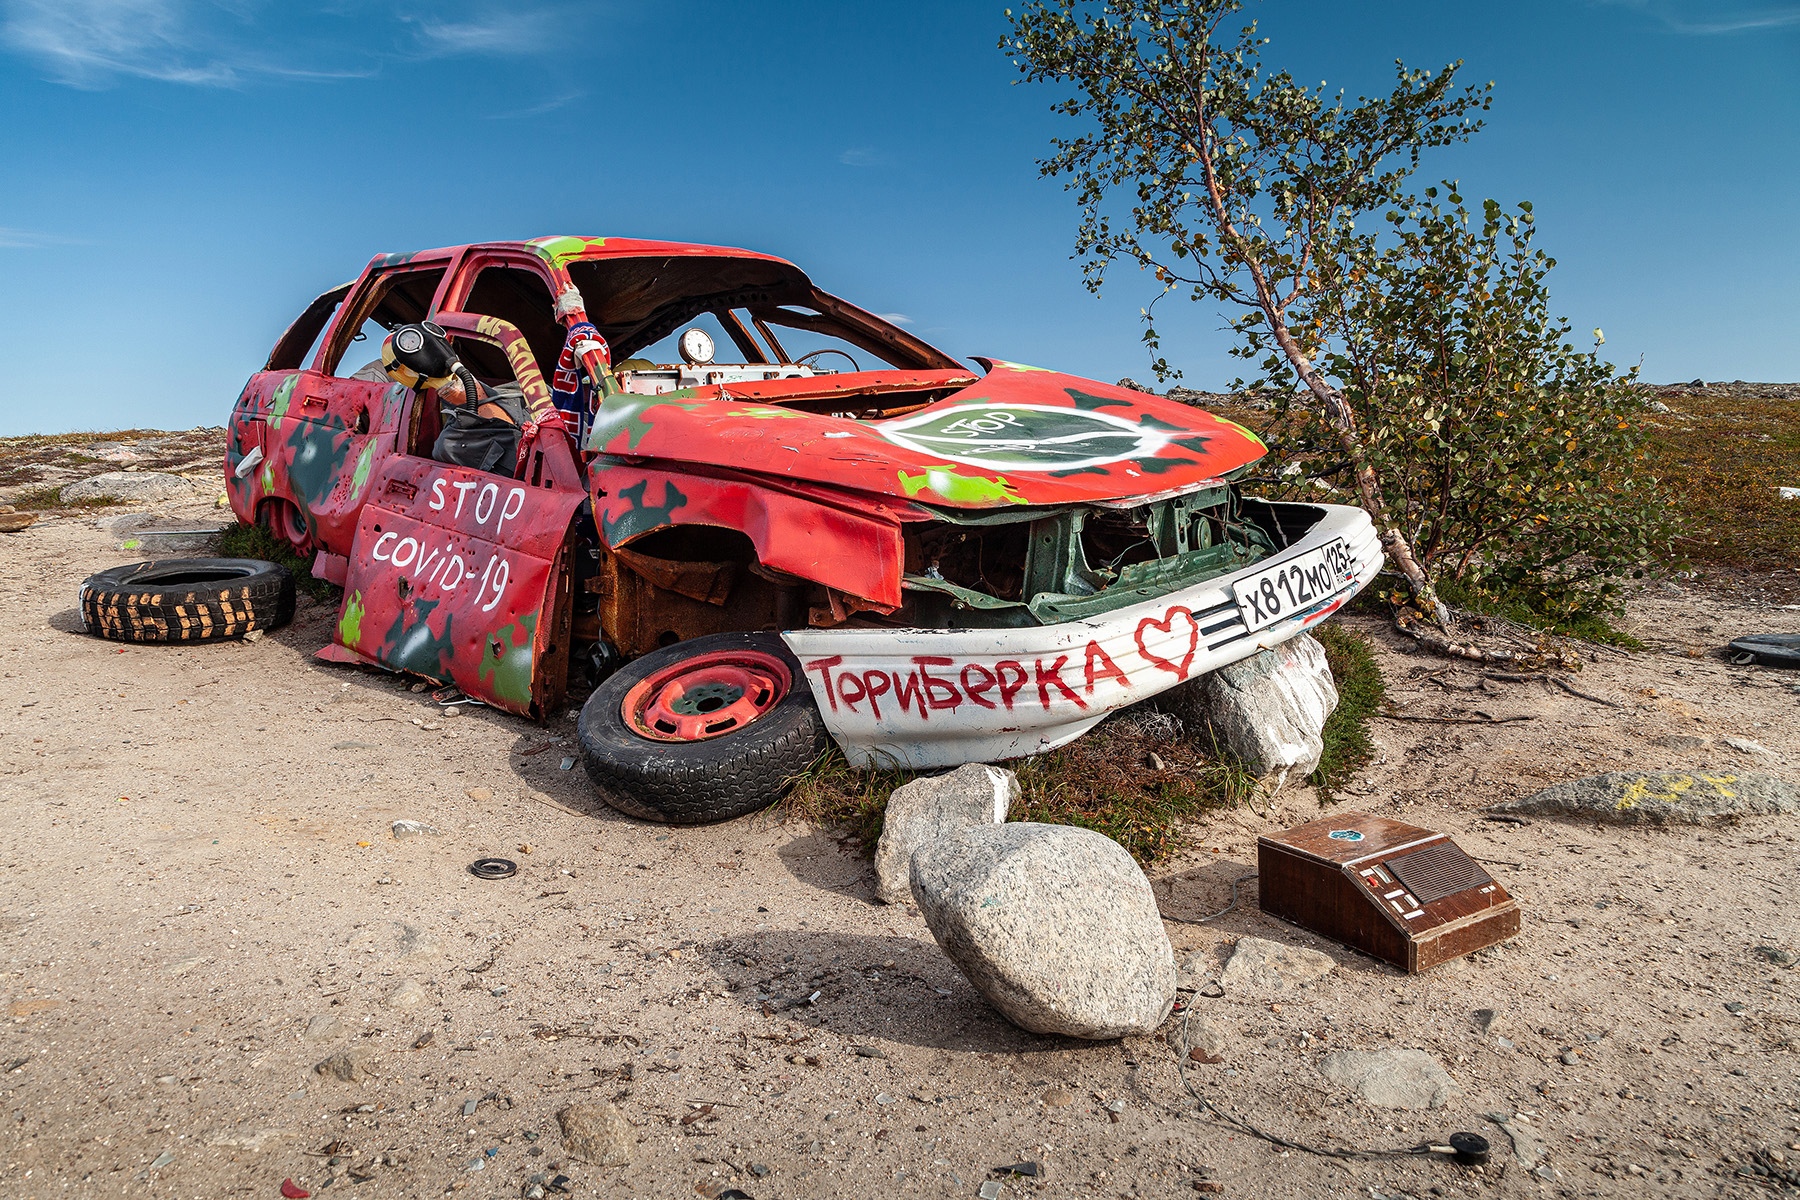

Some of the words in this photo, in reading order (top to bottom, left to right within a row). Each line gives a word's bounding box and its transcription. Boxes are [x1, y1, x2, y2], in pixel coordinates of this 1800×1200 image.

[940, 411, 1025, 438] STOP
[428, 478, 526, 535] STOP
[1326, 542, 1349, 575] 125
